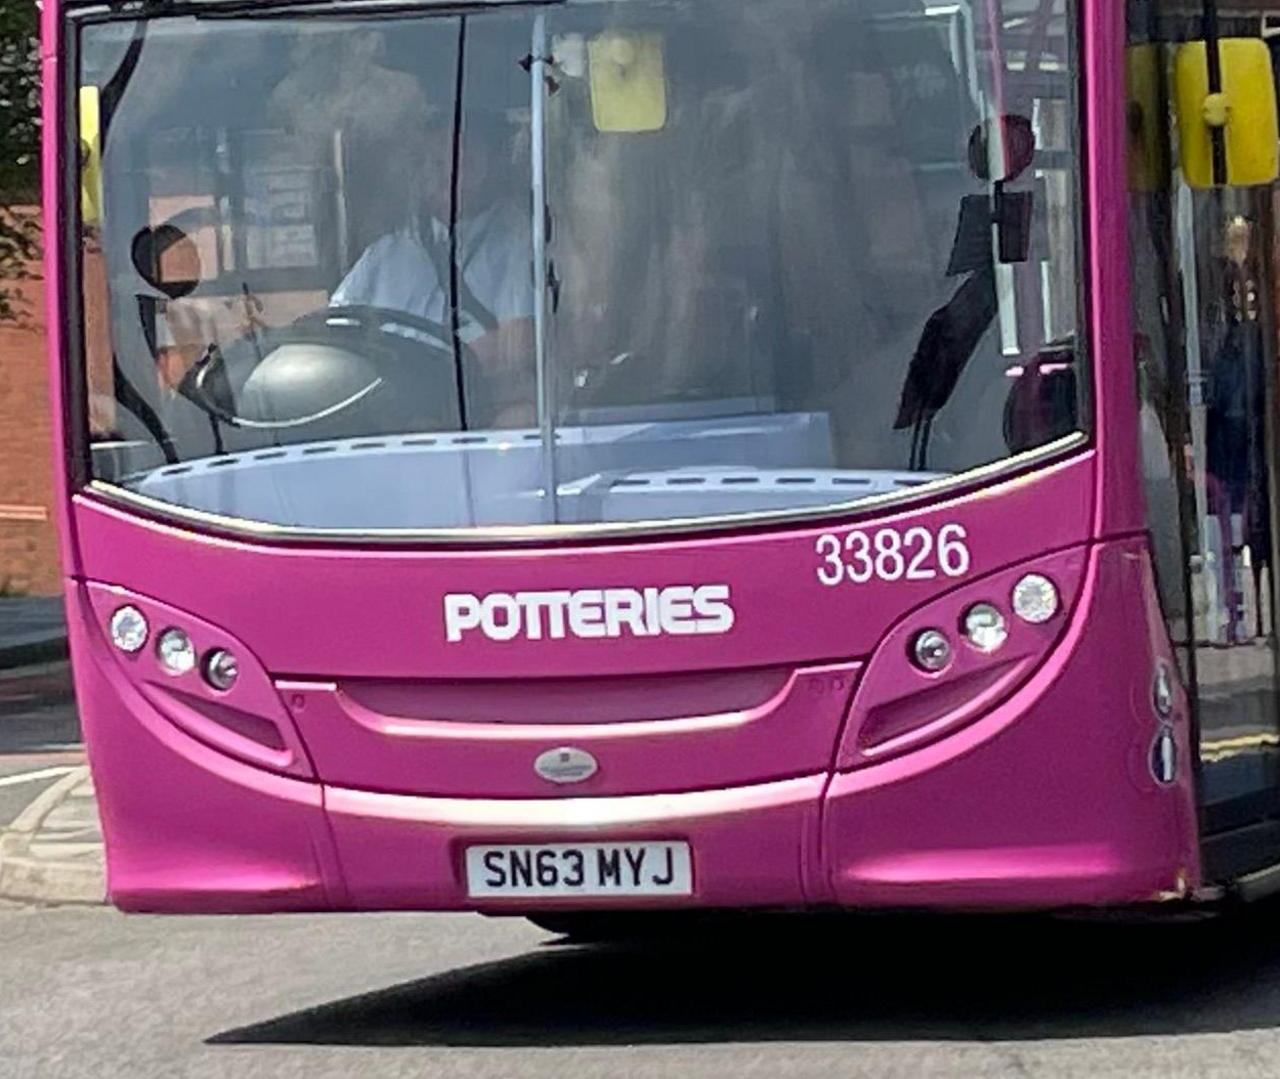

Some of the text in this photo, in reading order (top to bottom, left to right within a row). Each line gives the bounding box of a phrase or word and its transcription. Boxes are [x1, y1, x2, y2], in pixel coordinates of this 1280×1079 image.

[815, 523, 970, 586] 33826
[444, 585, 734, 642] POTTERIES
[483, 846, 674, 887] SN63 MYJ
